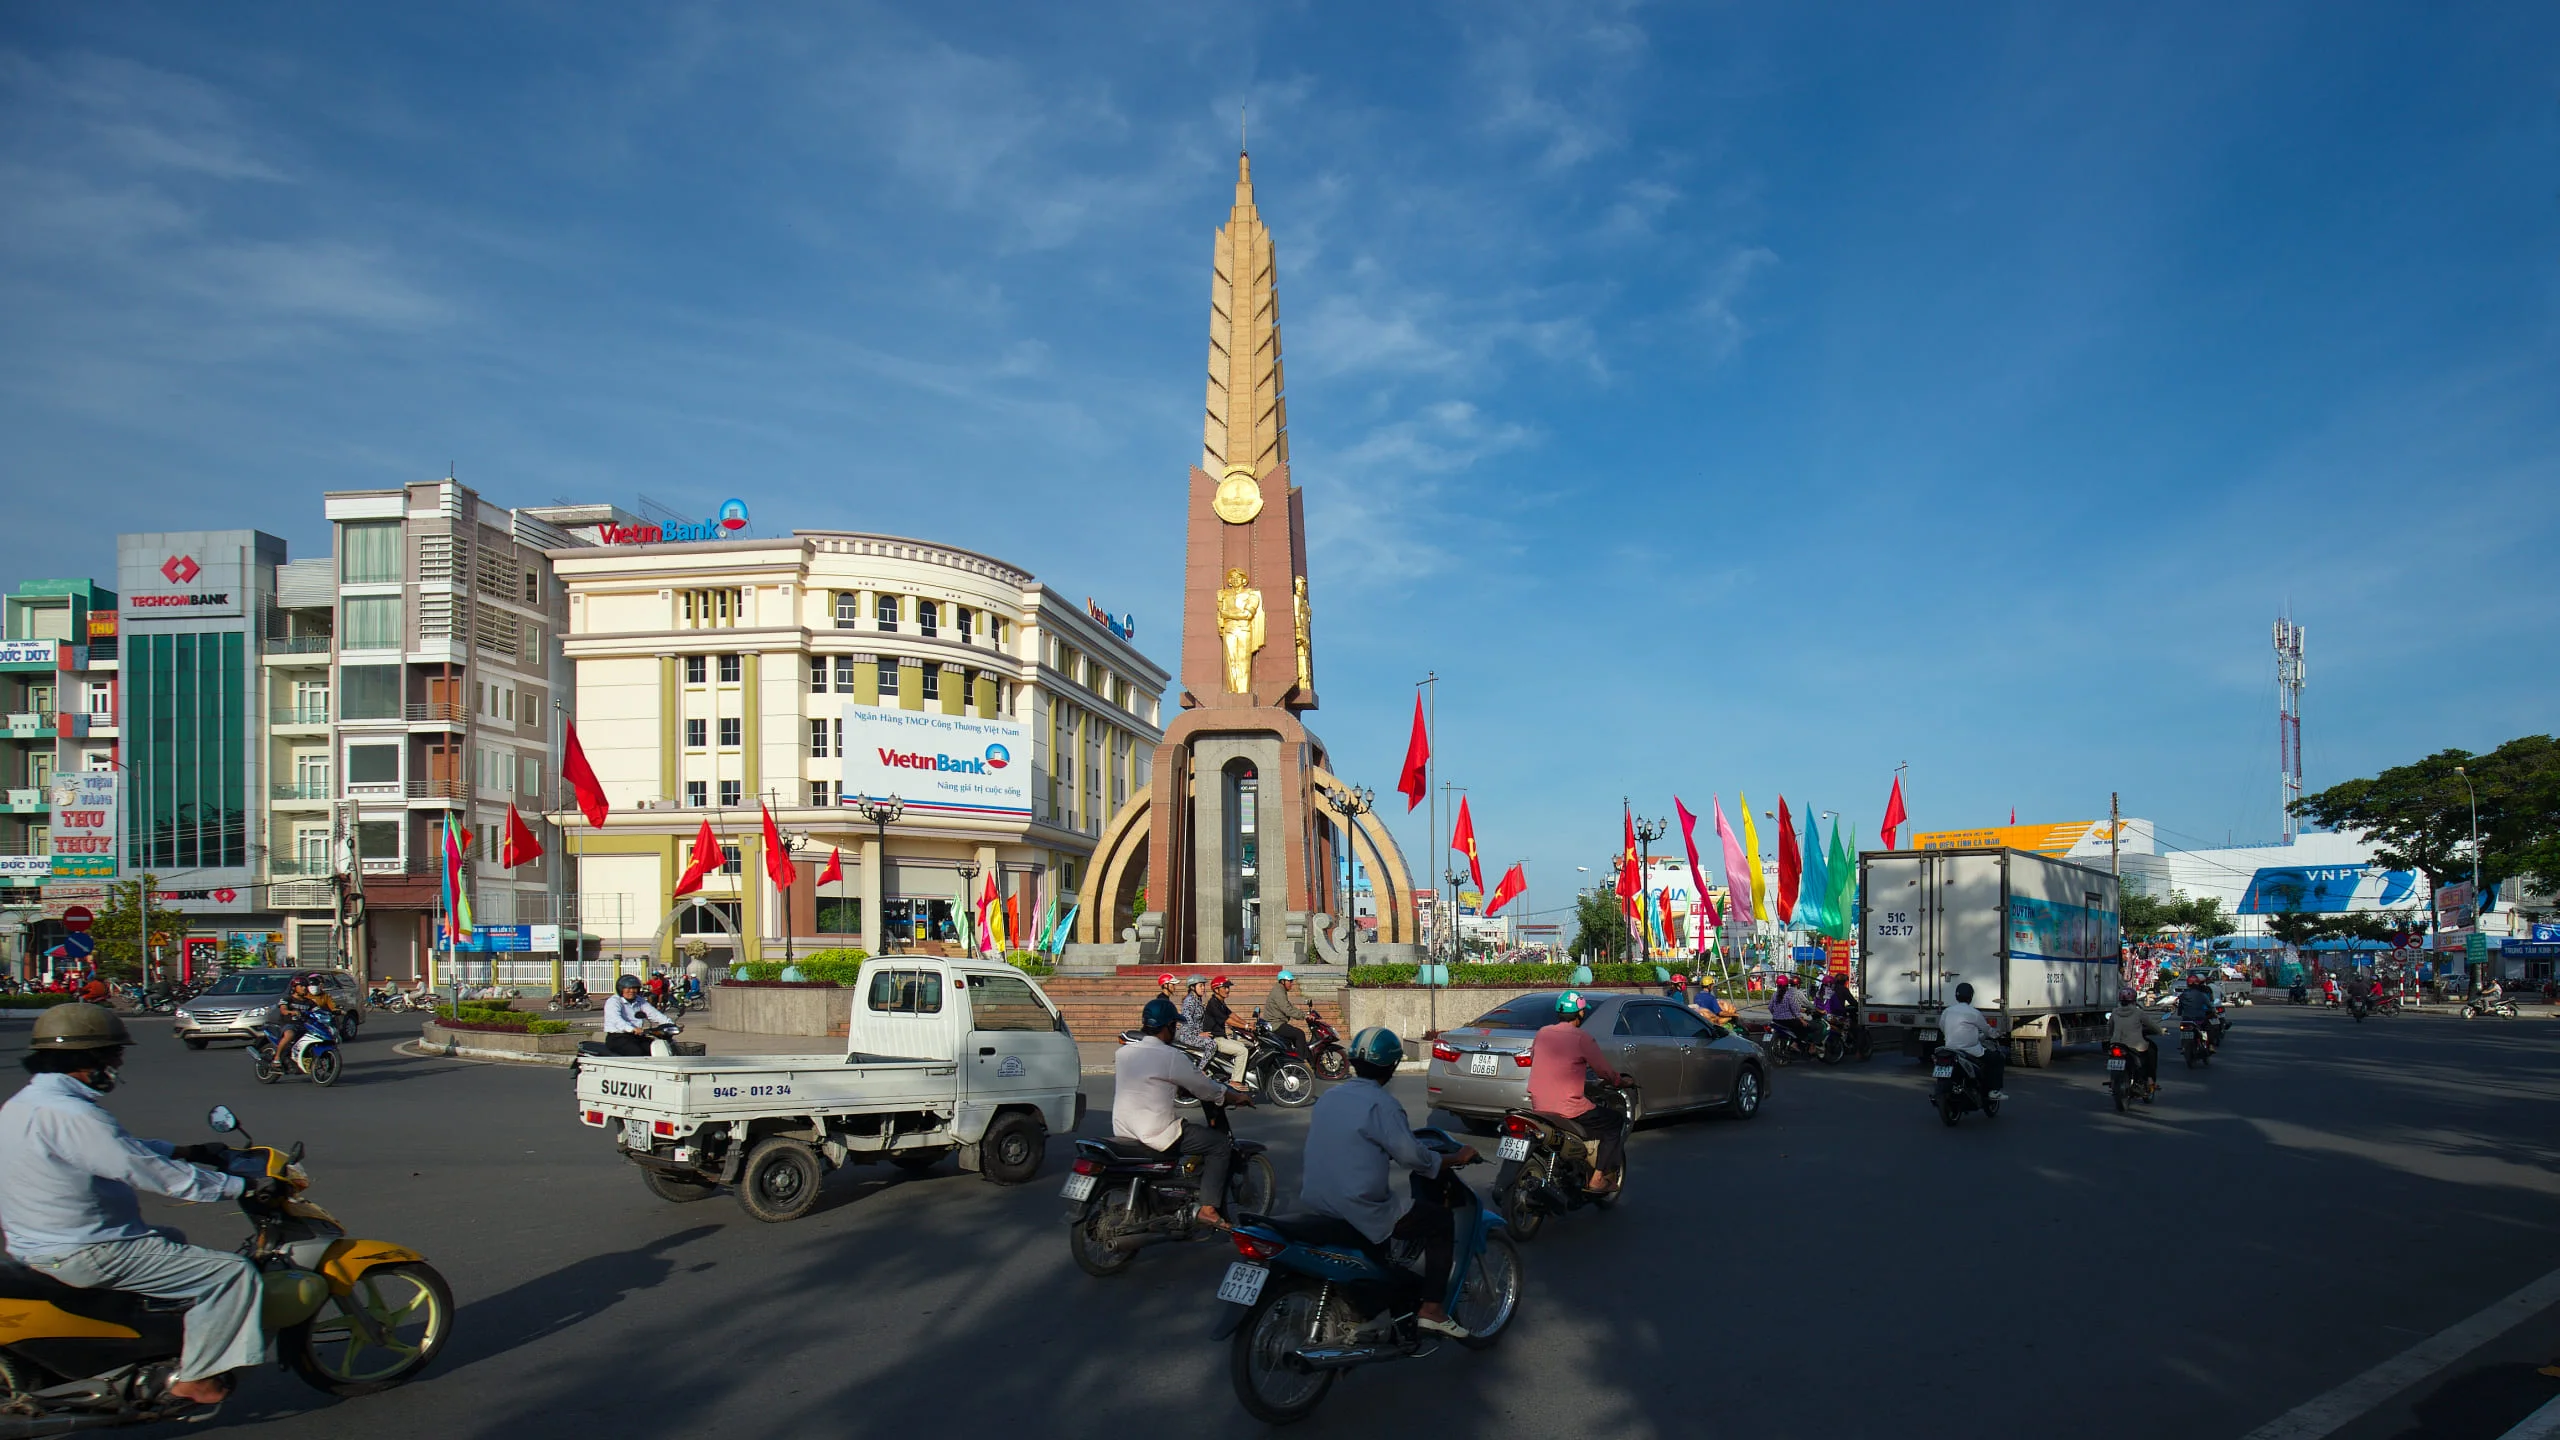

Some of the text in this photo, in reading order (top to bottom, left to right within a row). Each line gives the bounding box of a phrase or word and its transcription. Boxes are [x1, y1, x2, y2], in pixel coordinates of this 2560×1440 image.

[597, 518, 720, 544] VietinBank
[131, 593, 229, 607] TECHCOMBANK
[90, 622, 116, 634] THU
[25, 649, 51, 661] DUY
[855, 711, 877, 721] Ngân
[880, 713, 903, 725] Hàng
[906, 716, 930, 726] TMCP
[932, 719, 952, 730] Công
[984, 724, 1000, 735] Việt
[1002, 727, 1020, 736] Nam
[877, 747, 987, 775] VietinBank
[83, 775, 113, 790] TIỆM
[937, 781, 1021, 796] Nâng giá trị cuộc sống
[80, 792, 113, 805] VÀNG
[61, 811, 105, 827] THU
[54, 830, 112, 853] THỦY
[1, 859, 52, 869] ĐỨC DUY
[2305, 868, 2366, 881] VNPT
[1887, 912, 1906, 923] 51C
[1878, 925, 1914, 936] 325.17
[601, 1079, 652, 1100] SUZUKI
[713, 1087, 738, 1098] 94C
